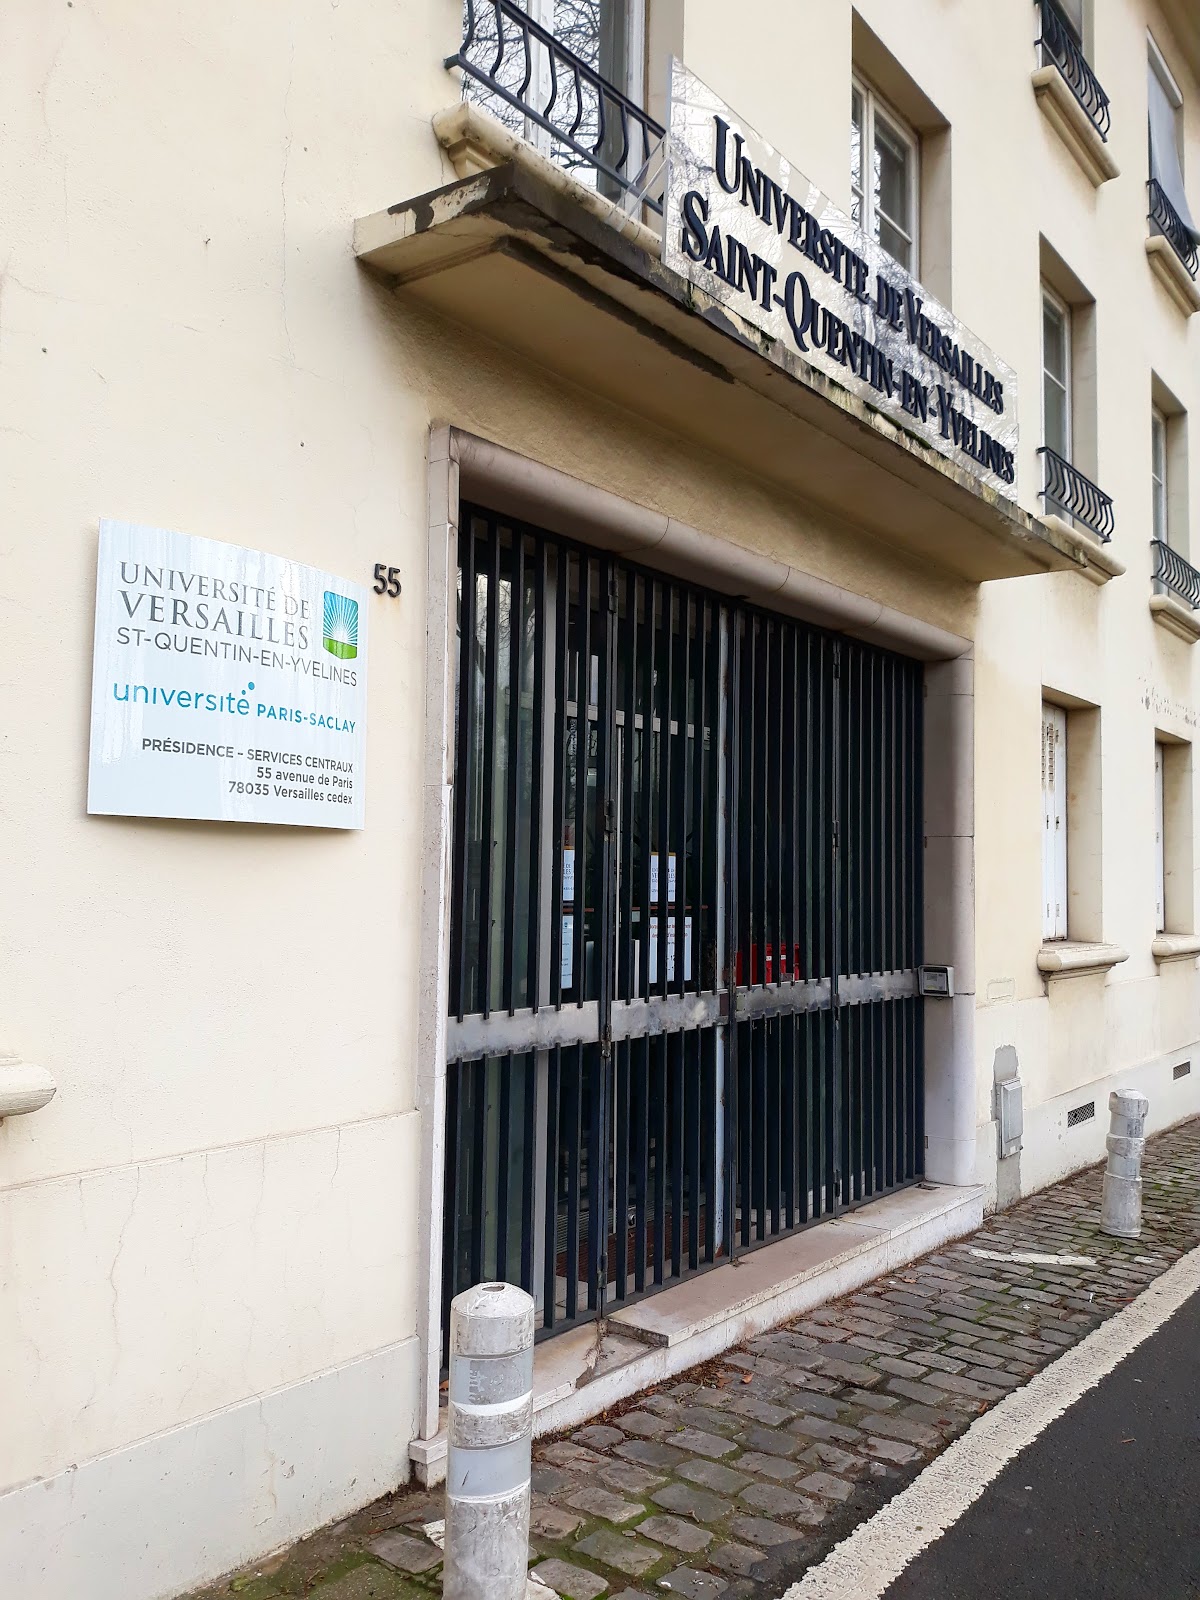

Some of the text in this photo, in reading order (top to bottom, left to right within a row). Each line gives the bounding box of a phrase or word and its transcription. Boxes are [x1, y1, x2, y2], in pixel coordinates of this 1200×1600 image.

[876, 275, 903, 332] DE
[903, 287, 1004, 415] VERSAILLES
[120, 561, 310, 620] UNIVERSITÉ DE
[373, 563, 402, 598] 55
[117, 589, 309, 650] VERSAILLES
[116, 626, 358, 687] ST-QUENTIN-EN-YVELINES
[257, 703, 356, 734] PARIS-SACLAY
[142, 737, 235, 759] PRÉSIDENCE
[247, 748, 303, 766] SERVICES
[305, 756, 354, 774] CENTRAUX
[228, 781, 353, 805] 78035 Versailles cedex
[256, 766, 353, 789] 55 avenue de Paris
